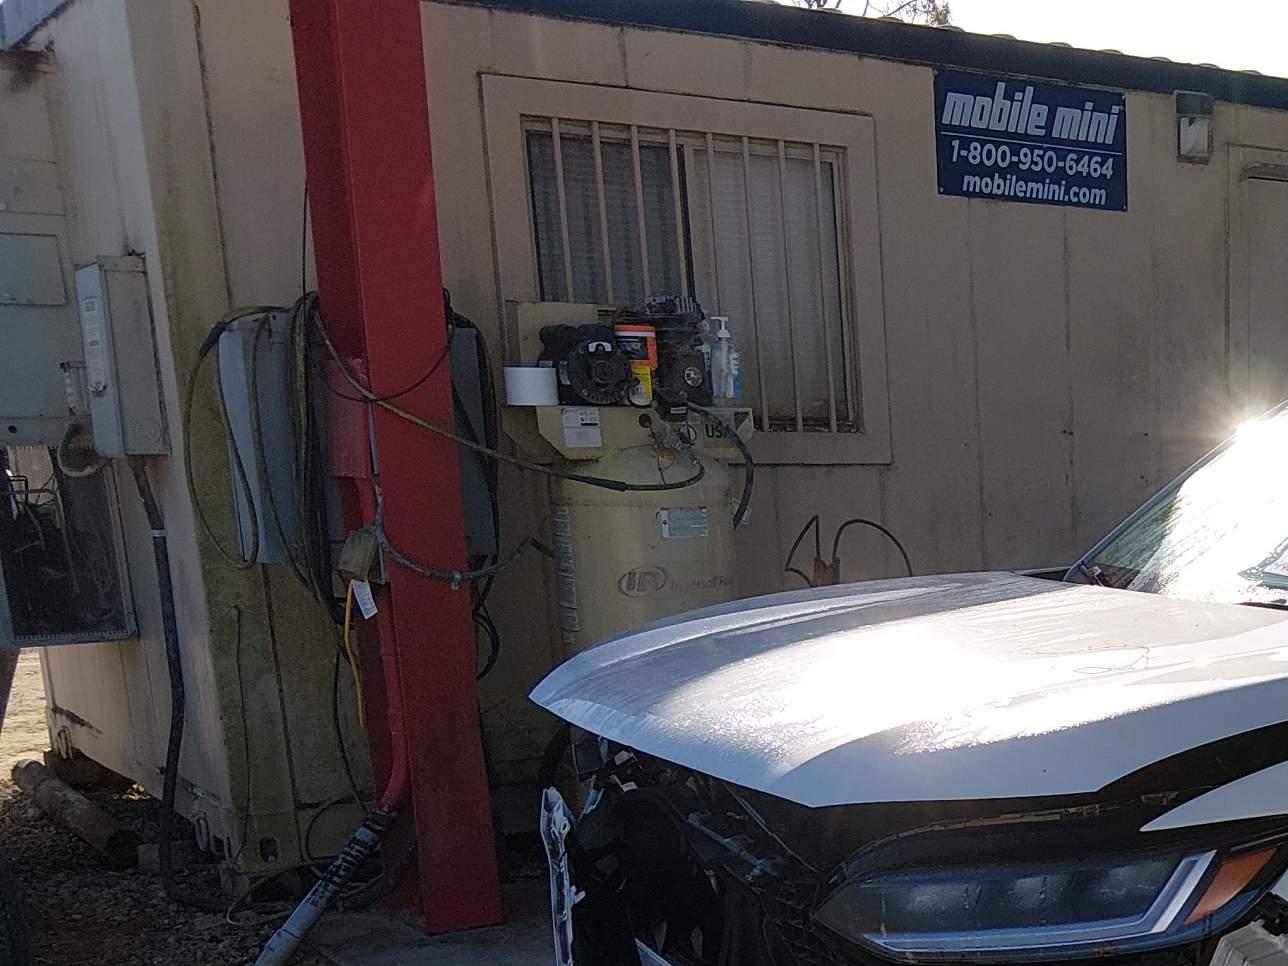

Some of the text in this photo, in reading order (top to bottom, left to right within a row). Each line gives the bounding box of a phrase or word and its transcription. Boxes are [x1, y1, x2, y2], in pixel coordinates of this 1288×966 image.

[941, 82, 1121, 145] mobile mini
[951, 140, 1114, 180] 1-800-950-6464
[962, 173, 1107, 206] mobilemini.com
